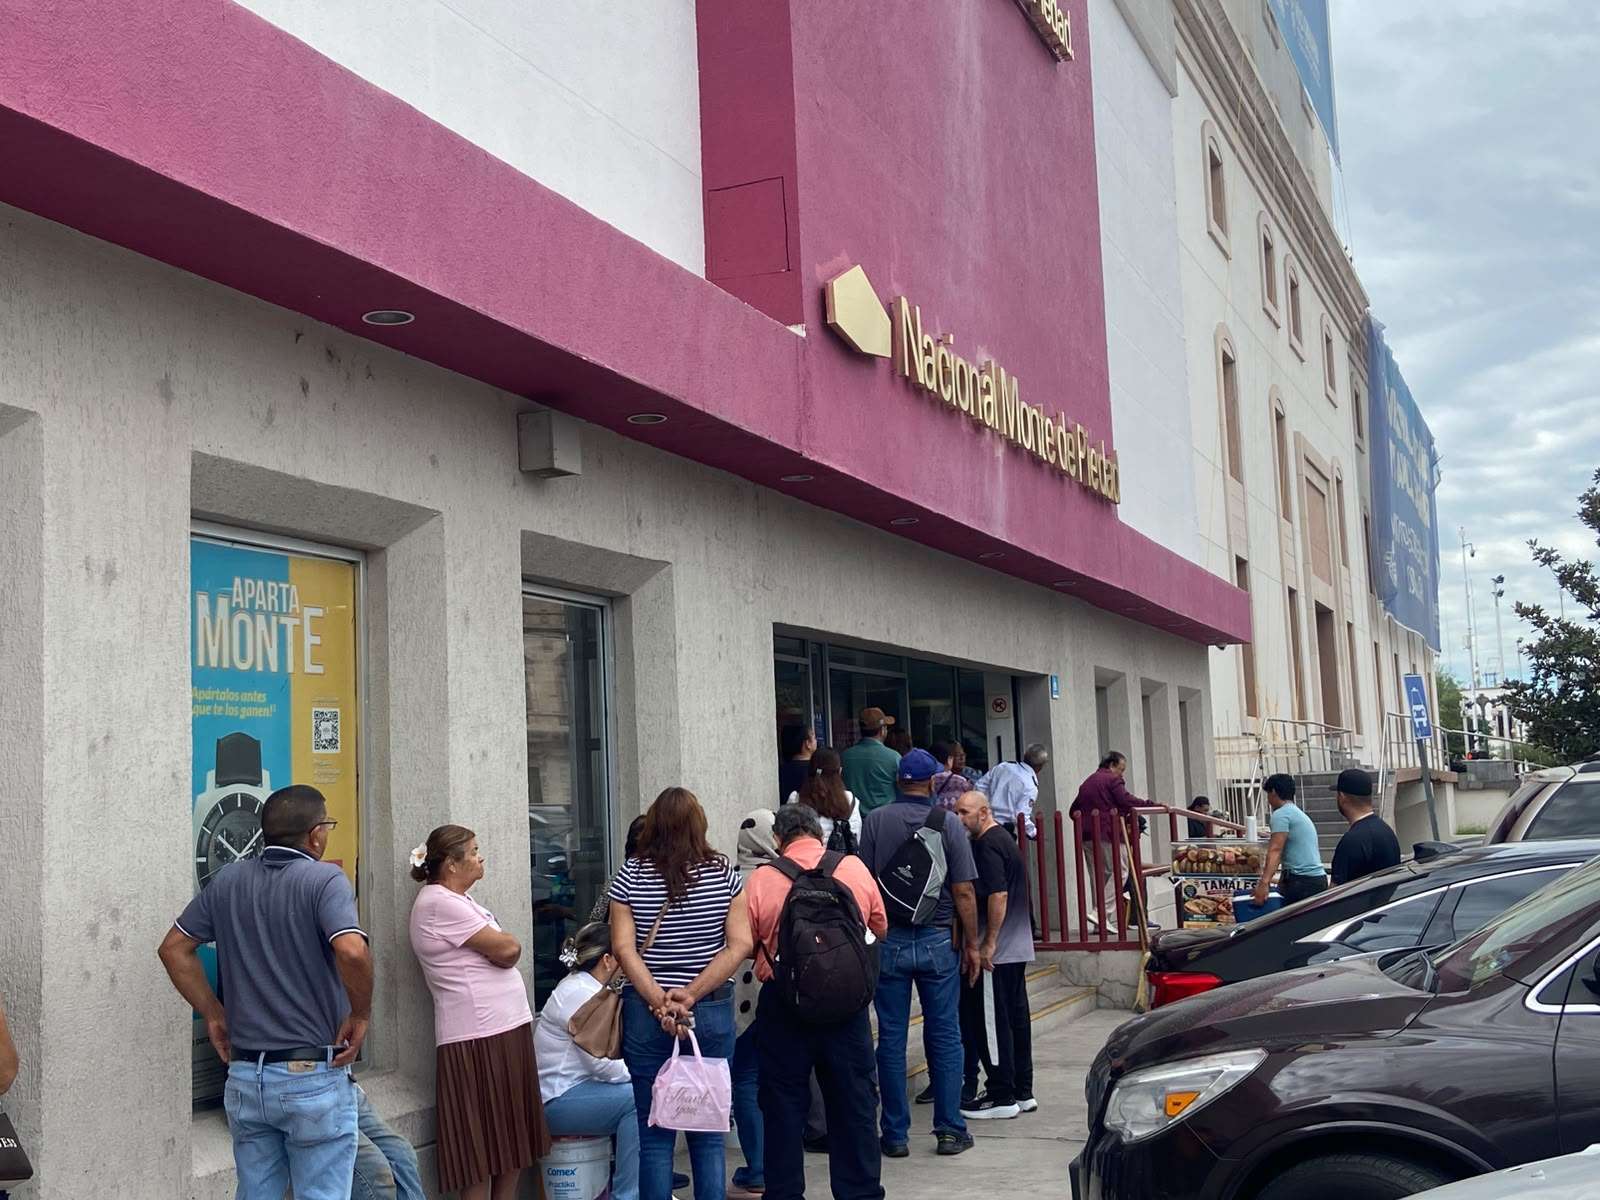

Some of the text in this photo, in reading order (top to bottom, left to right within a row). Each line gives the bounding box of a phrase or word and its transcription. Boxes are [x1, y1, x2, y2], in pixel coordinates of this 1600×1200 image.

[898, 295, 1121, 505] Nacional Monte de Piedad
[231, 576, 300, 613] APARTA
[195, 591, 325, 675] MONTE
[225, 703, 239, 716] los
[240, 691, 267, 703] antes
[547, 1167, 577, 1177] Comex
